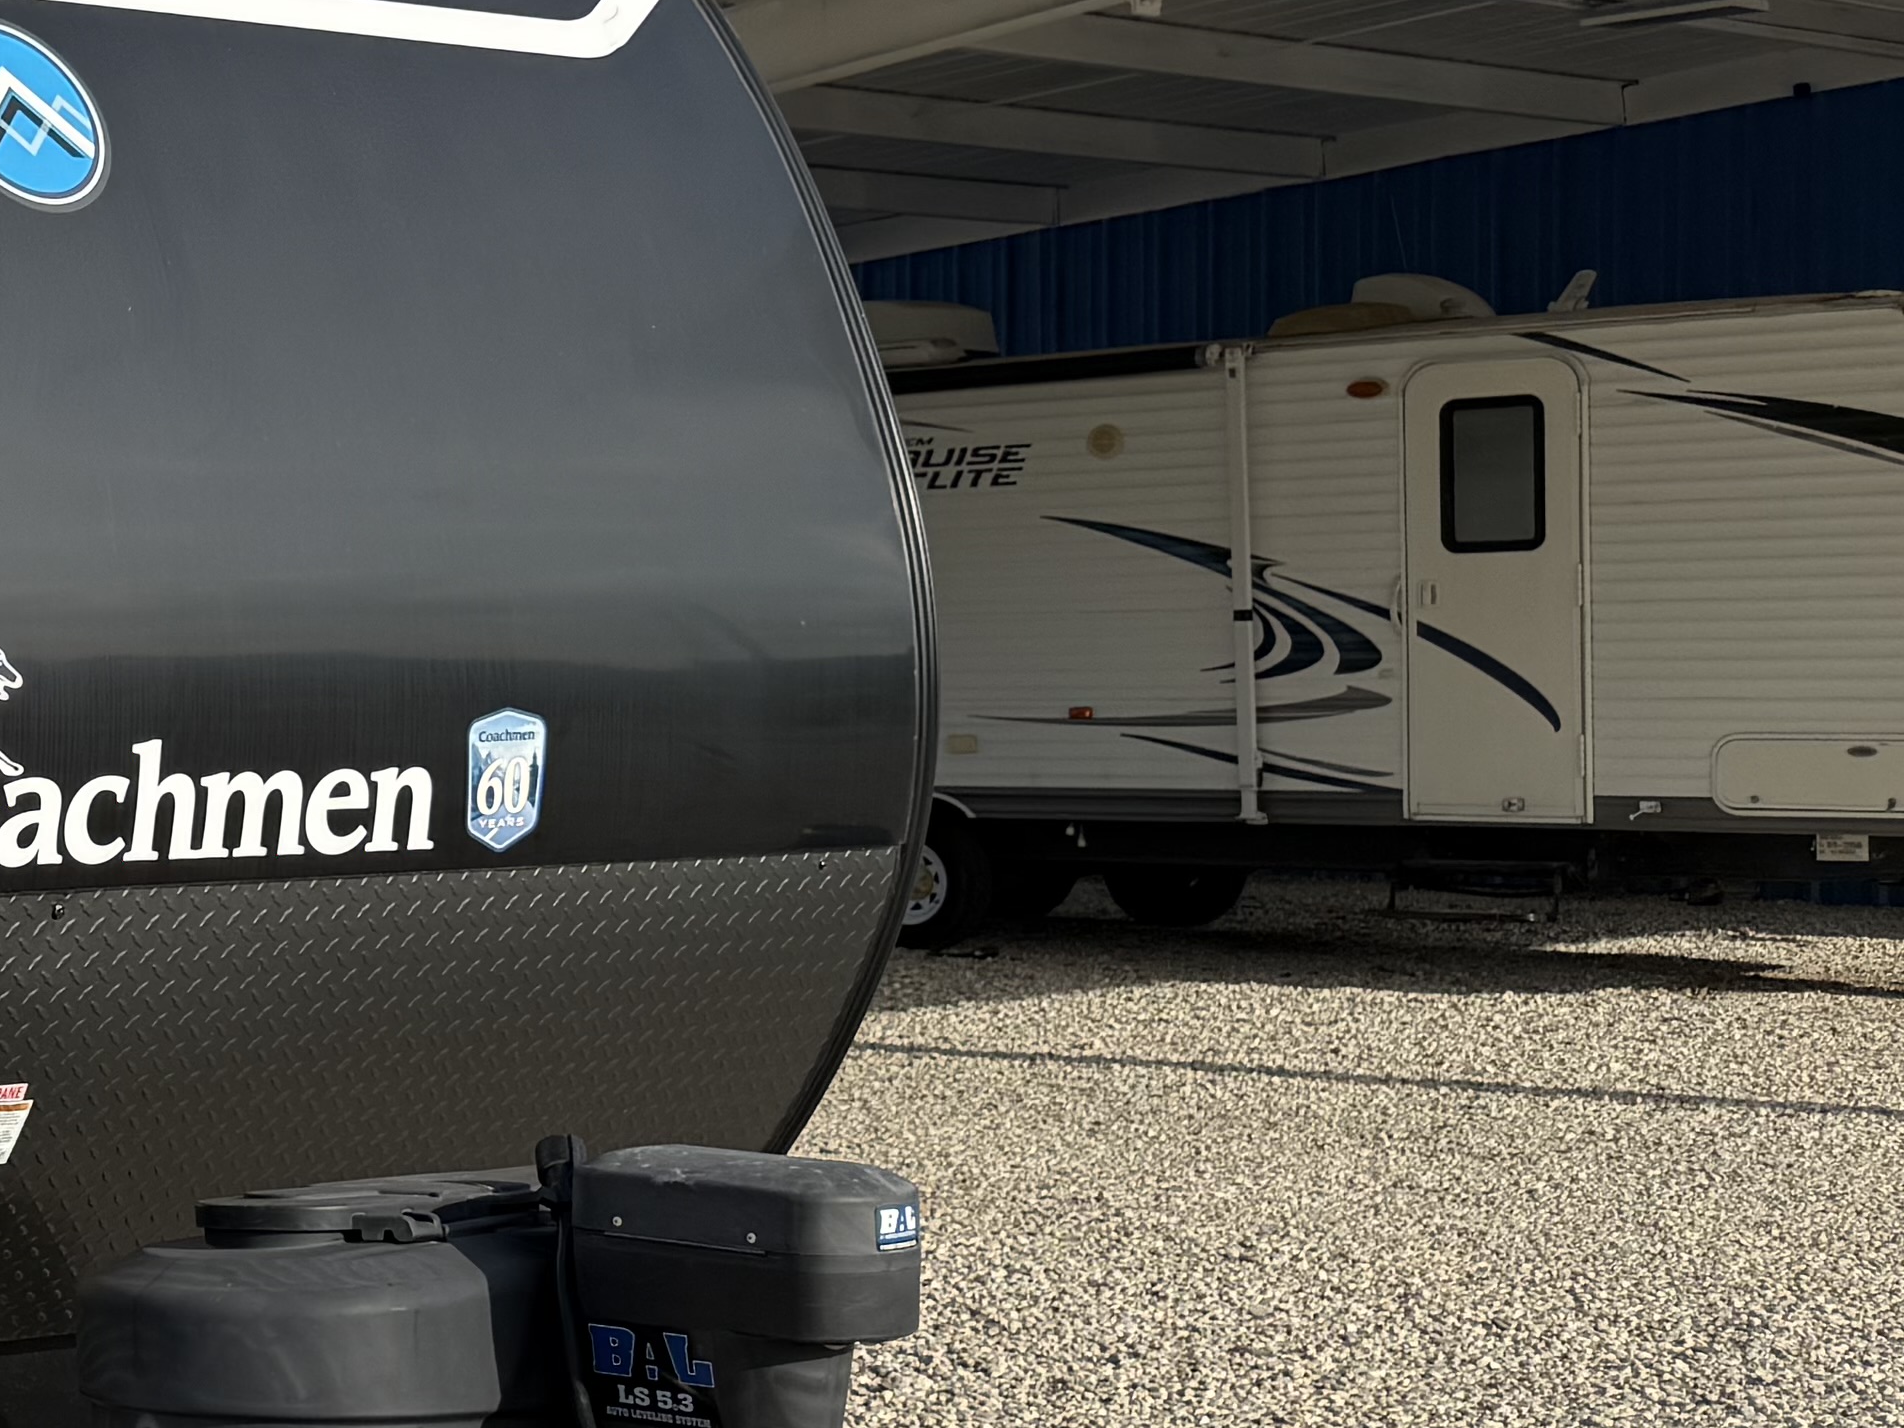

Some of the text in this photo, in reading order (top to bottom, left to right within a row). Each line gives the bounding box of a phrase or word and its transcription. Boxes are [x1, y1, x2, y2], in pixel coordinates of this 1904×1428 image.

[478, 728, 536, 743] Coachmen
[476, 756, 531, 816] 60
[478, 816, 525, 829] YEARS
[617, 1384, 694, 1413] LS 5.3
